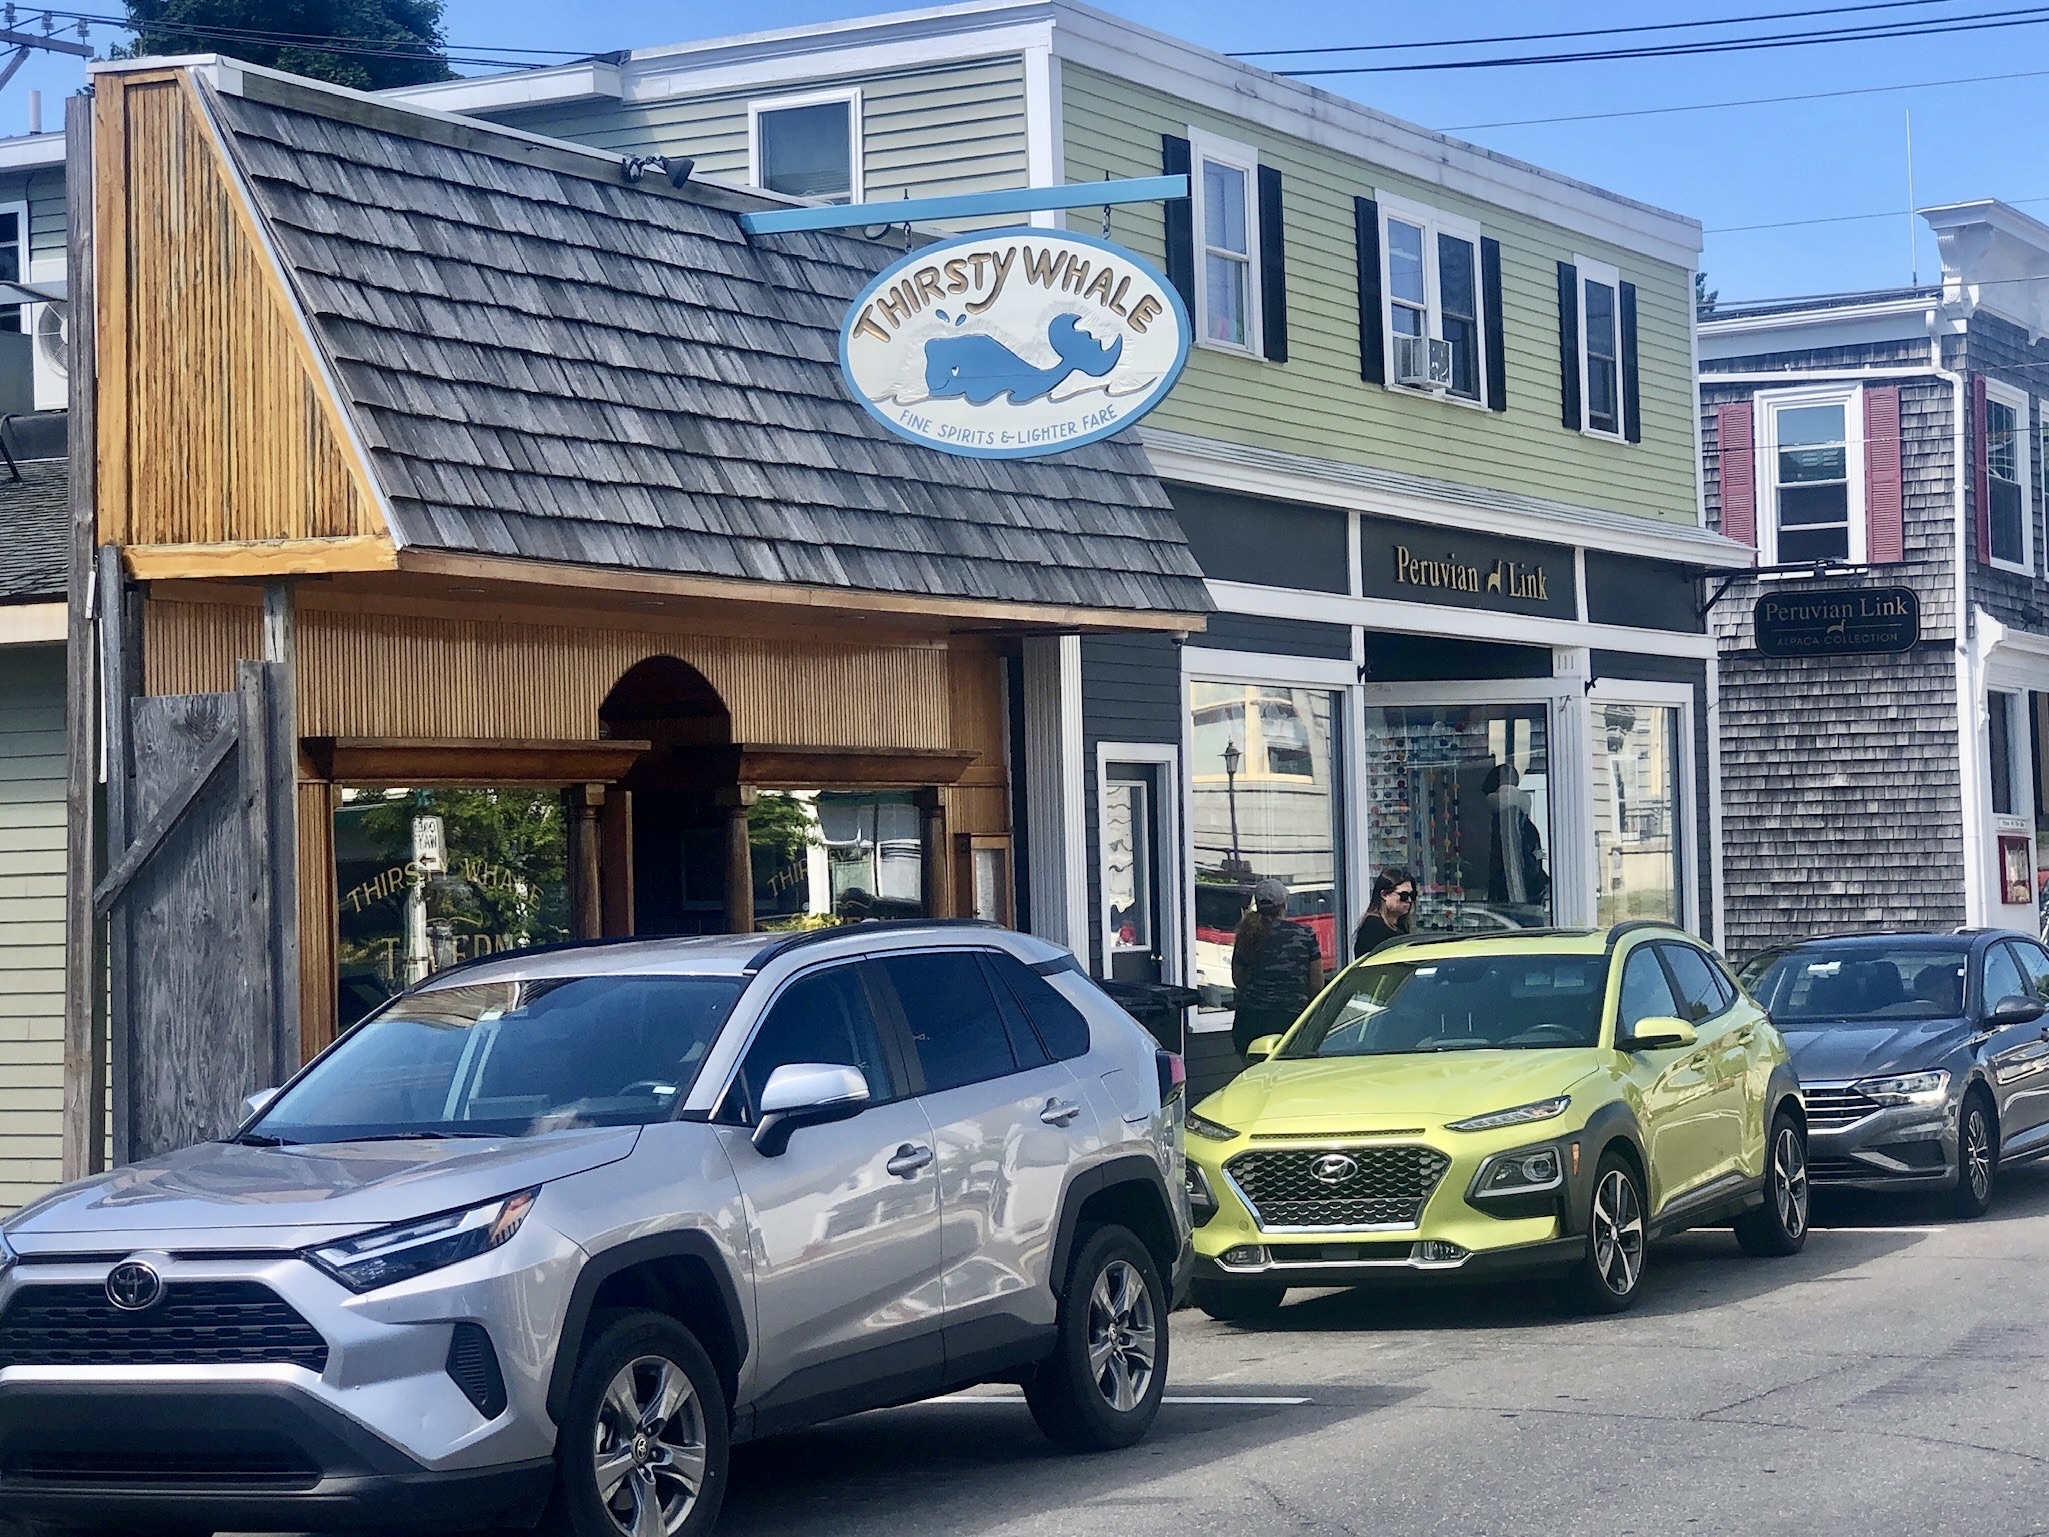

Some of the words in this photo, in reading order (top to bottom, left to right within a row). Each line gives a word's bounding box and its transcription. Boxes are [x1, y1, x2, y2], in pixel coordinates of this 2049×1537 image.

[852, 246, 1017, 344] THIRSTY
[1023, 245, 1163, 335] WHALE
[899, 409, 933, 434] FINE
[937, 424, 995, 445] SPIRITS
[1017, 419, 1079, 444] LIGHTER
[1082, 404, 1118, 435] FARE
[1395, 545, 1480, 593] Peruvian
[1507, 561, 1549, 600] Link
[1764, 600, 1853, 622] Peruvian
[1860, 596, 1909, 617] Link
[1776, 635, 1820, 647] ALPACA
[1824, 633, 1898, 645] COLLECTION
